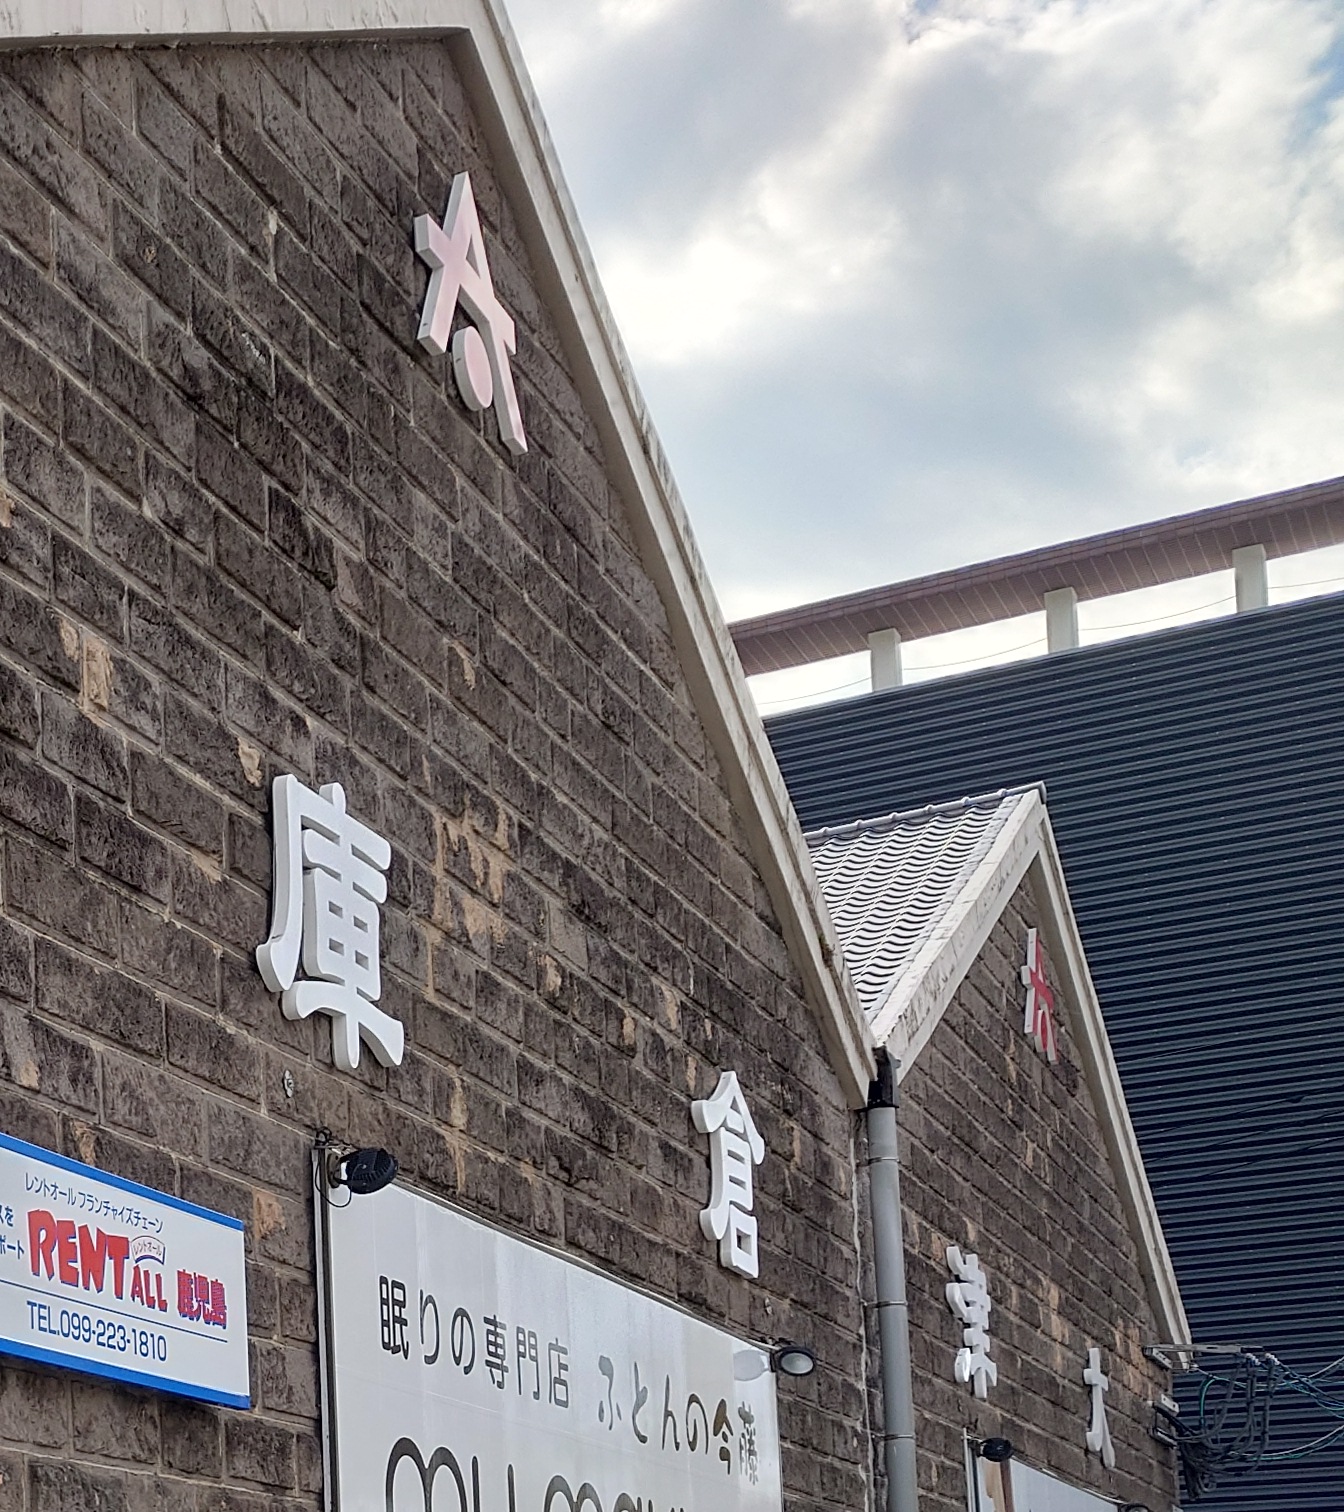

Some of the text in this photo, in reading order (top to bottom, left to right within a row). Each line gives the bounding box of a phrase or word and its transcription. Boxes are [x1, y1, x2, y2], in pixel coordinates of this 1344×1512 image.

[256, 774, 405, 1071] 庫
[25, 1172, 163, 1233] レントオール フランチャイズチェーン
[691, 1071, 765, 1279] 倉
[27, 1300, 167, 1362] TEL.099-223-1810
[177, 1269, 228, 1329] 鹿児島
[379, 1275, 760, 1485] 眠りの専門店 ふとんの今藤
[1083, 1348, 1116, 1468] 大
